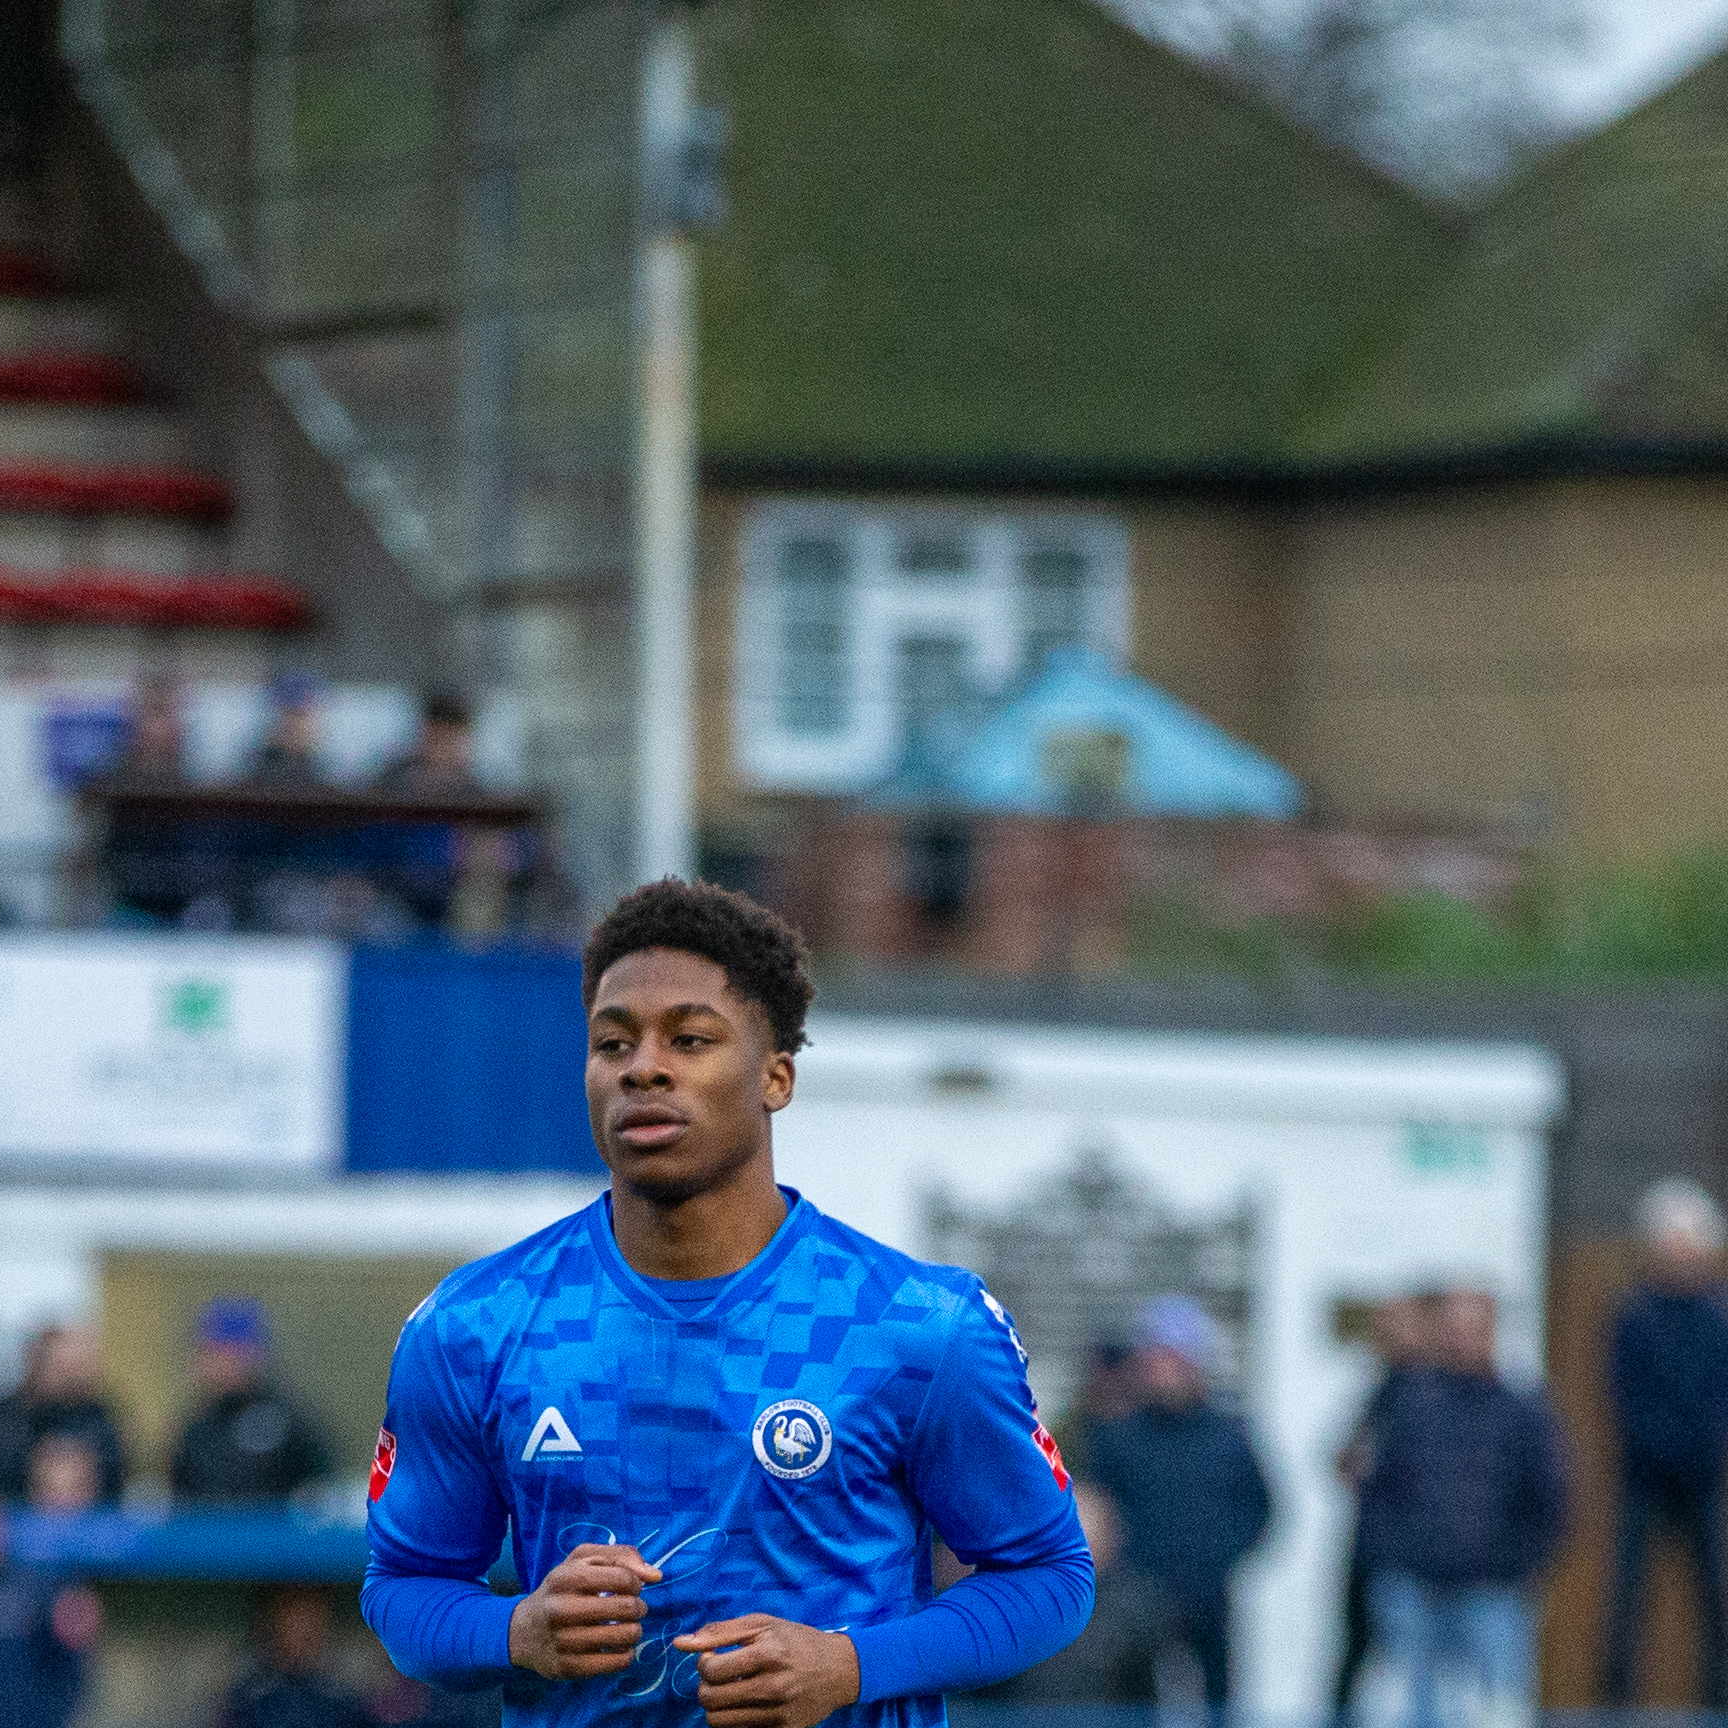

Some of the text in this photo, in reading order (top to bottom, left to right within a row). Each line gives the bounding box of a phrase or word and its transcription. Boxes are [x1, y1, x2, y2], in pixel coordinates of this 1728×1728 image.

[756, 1401, 830, 1436] MARLOW FOOTBALL CLUB
[764, 1461, 799, 1478] FOUNDED
